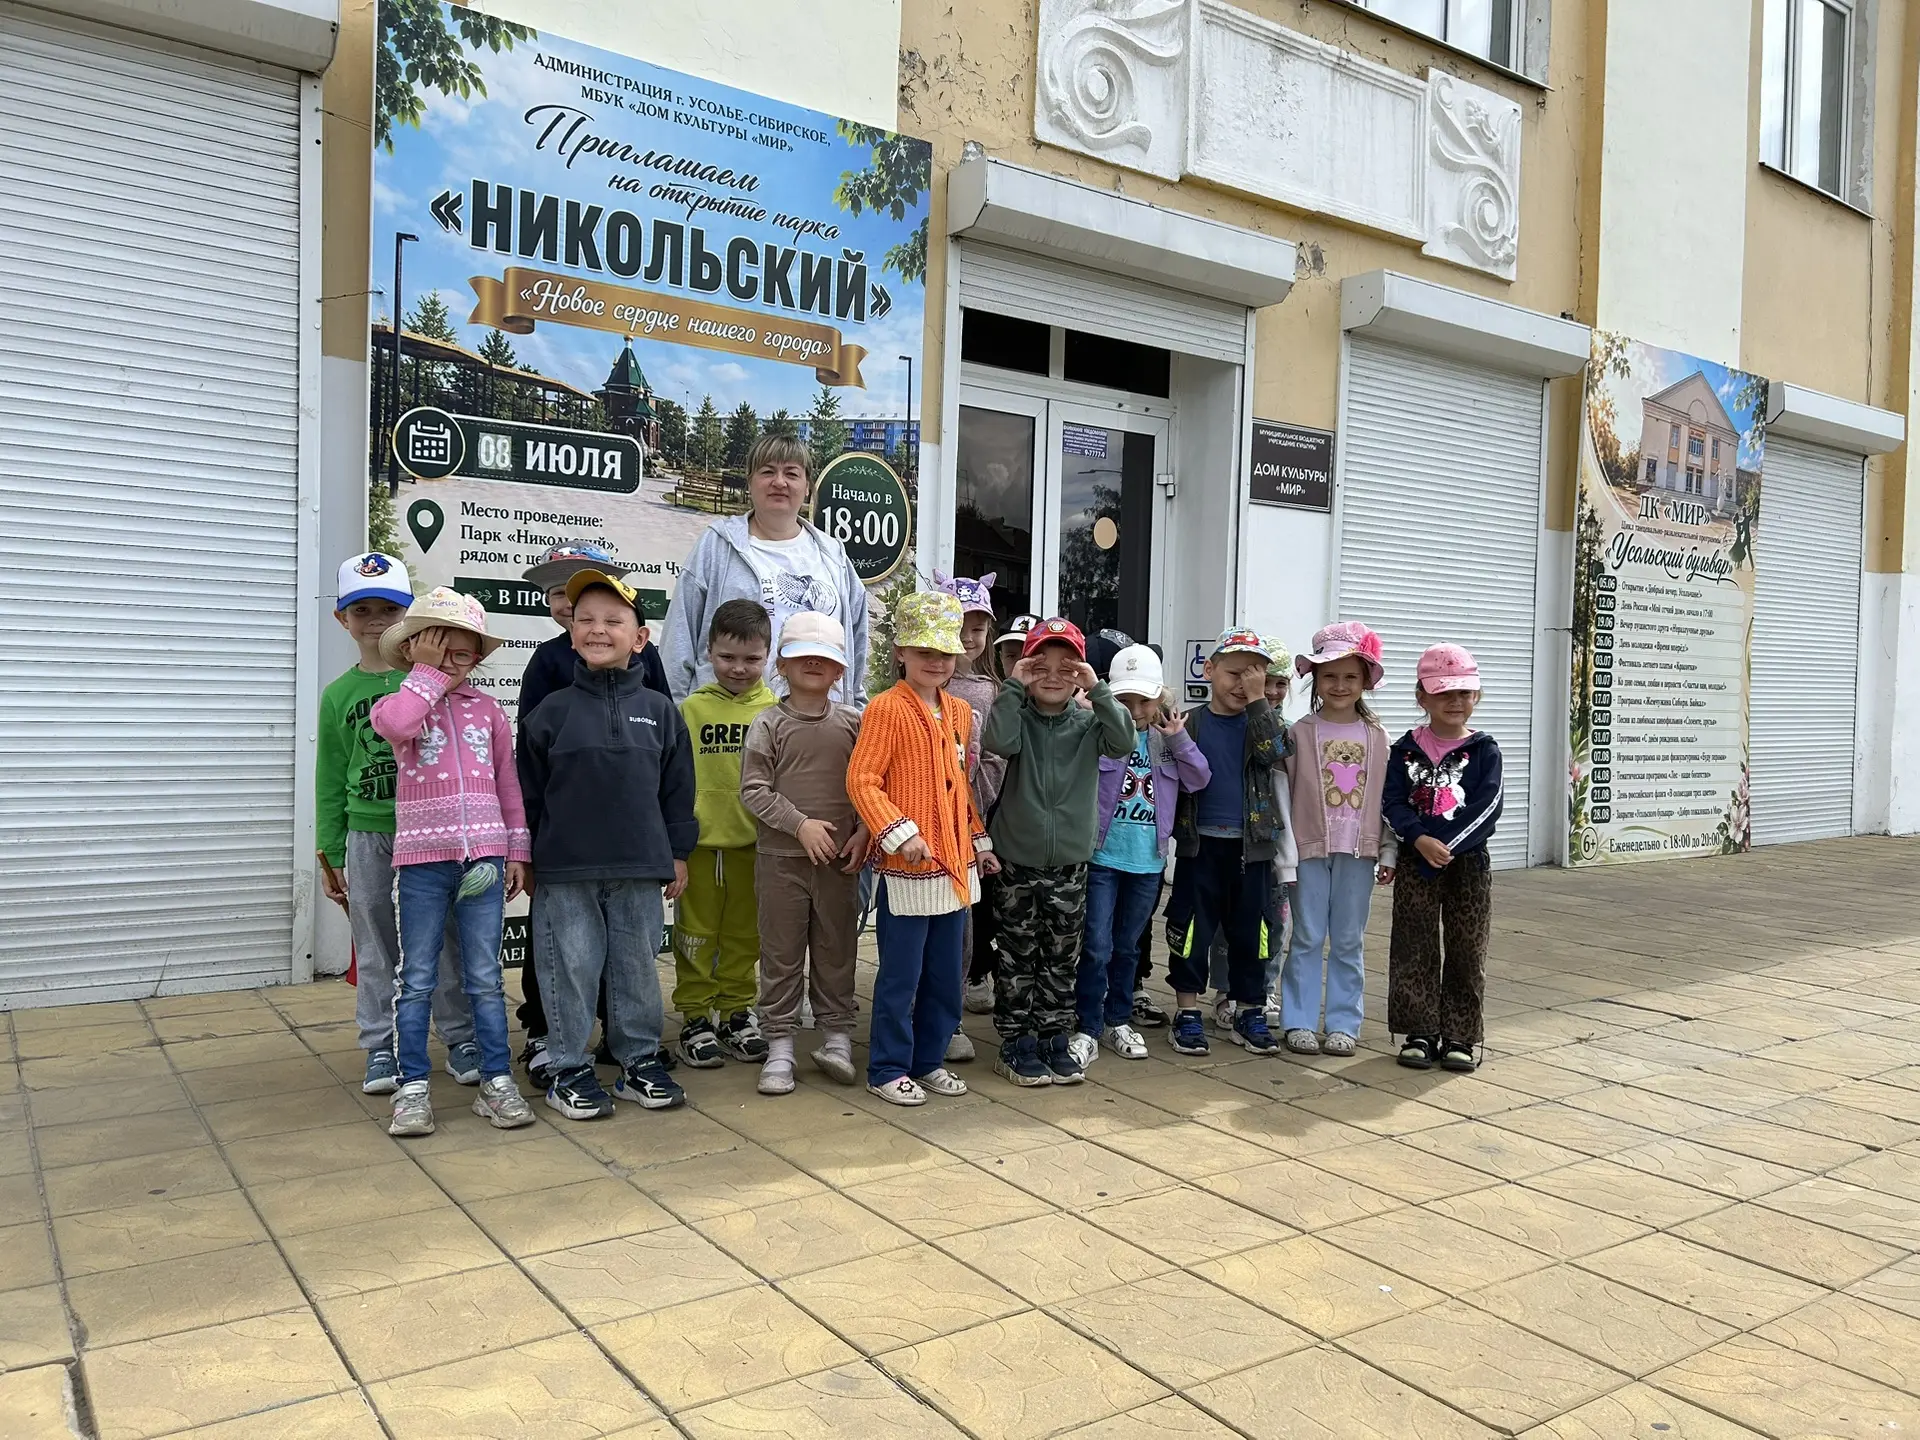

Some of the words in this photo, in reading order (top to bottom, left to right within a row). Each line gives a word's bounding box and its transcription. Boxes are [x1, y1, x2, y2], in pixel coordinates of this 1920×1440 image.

[534, 53, 672, 103] АДМИНИСТРАЦИЯ
[676, 95, 685, 106] г.
[689, 97, 831, 146] УСОЛЬЕ-СИБИРСКОЕ,
[581, 86, 624, 109] МБУК
[628, 101, 670, 120] «ДОМ
[674, 111, 748, 141] КУЛЬТУРЫ
[752, 133, 794, 152] «МИР»
[524, 104, 761, 193] Приглашаем
[608, 174, 642, 194] на
[649, 182, 768, 222] открытие
[772, 214, 840, 246] парка
[429, 178, 893, 324] «НИКОЛЬСКИЙ»
[520, 279, 605, 316] «Новое
[612, 304, 680, 335] сердце
[687, 317, 756, 344] нашего
[763, 331, 833, 361] города»
[526, 440, 622, 480] ИЮЛЯ
[1254, 462, 1280, 477] ДОМ
[1282, 466, 1327, 483] КУЛЬТУРЫ
[832, 484, 880, 504] Начало
[884, 494, 893, 505] в
[1276, 482, 1306, 496] «МИР»
[460, 501, 509, 520] Место
[514, 511, 604, 528] проведение:
[1638, 496, 1660, 520] ДК
[1664, 501, 1710, 526] «МИР»
[822, 506, 899, 547] 18:00
[460, 525, 502, 545] Парк
[460, 550, 508, 564] рядом
[513, 554, 522, 564] с
[1604, 532, 1684, 579] «Усольский
[1685, 546, 1734, 584] бульвар»
[1600, 578, 1616, 590] 05.06
[498, 589, 510, 605] В
[1598, 596, 1614, 609] 12.06
[1597, 616, 1613, 628] 19.06
[1596, 634, 1612, 648] 26.06
[1595, 655, 1611, 667] 03.07
[1595, 674, 1610, 686] 10.07
[1594, 693, 1610, 705] 17.07
[1594, 712, 1609, 724] 24.07
[1594, 732, 1609, 742] 31.07
[699, 746, 720, 754] SPACE
[1593, 751, 1610, 762] 07.08
[368, 762, 397, 776] KIC
[1594, 770, 1610, 782] 14.08
[1593, 790, 1610, 800] 21.08
[1593, 808, 1609, 820] 28.08
[1583, 833, 1596, 852] 6+
[1609, 838, 1660, 853] Еженедельно
[1664, 840, 1668, 850] с
[1670, 834, 1690, 849] 18:00
[1692, 836, 1700, 848] до
[1701, 832, 1720, 846] 20:00
